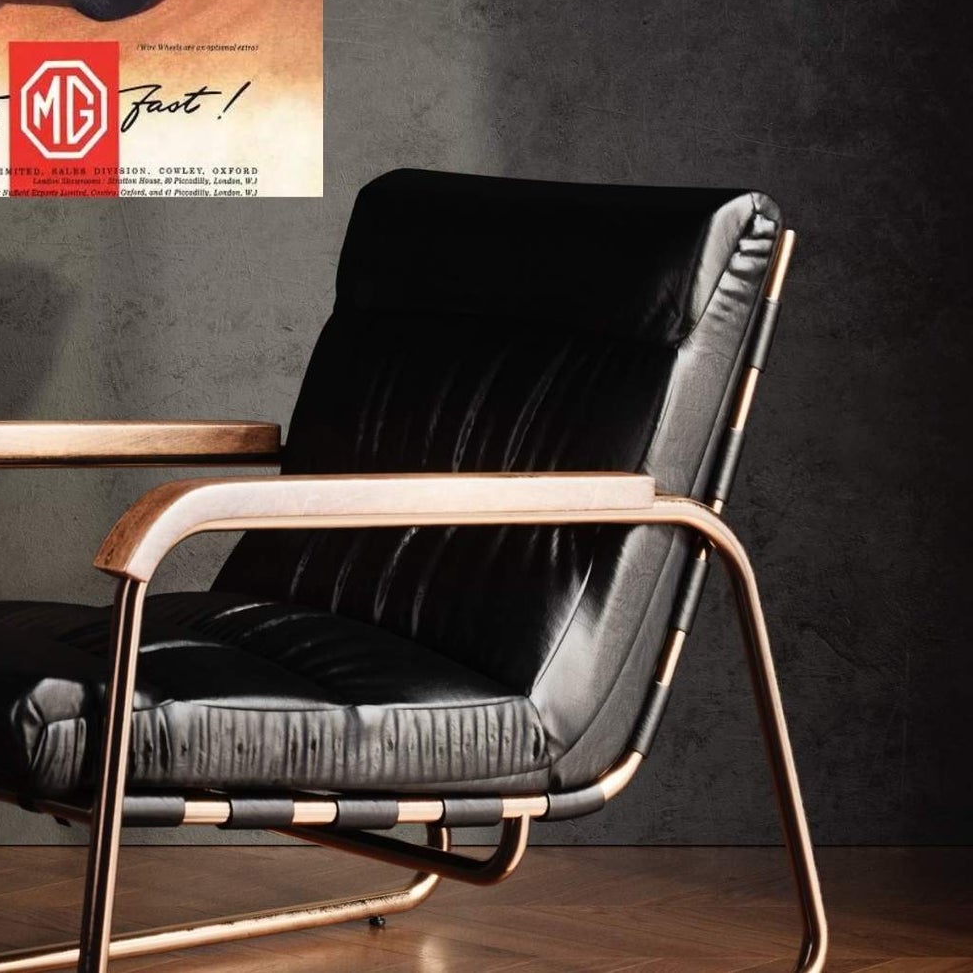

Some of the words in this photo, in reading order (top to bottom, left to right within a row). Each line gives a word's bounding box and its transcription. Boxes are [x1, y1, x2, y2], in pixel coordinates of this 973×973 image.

[216, 81, 252, 119] !
[33, 75, 95, 144] MG
[212, 167, 258, 175] OXFORD
[174, 177, 211, 186] Piccadilly,
[213, 177, 243, 186] London,
[148, 189, 163, 197] and
